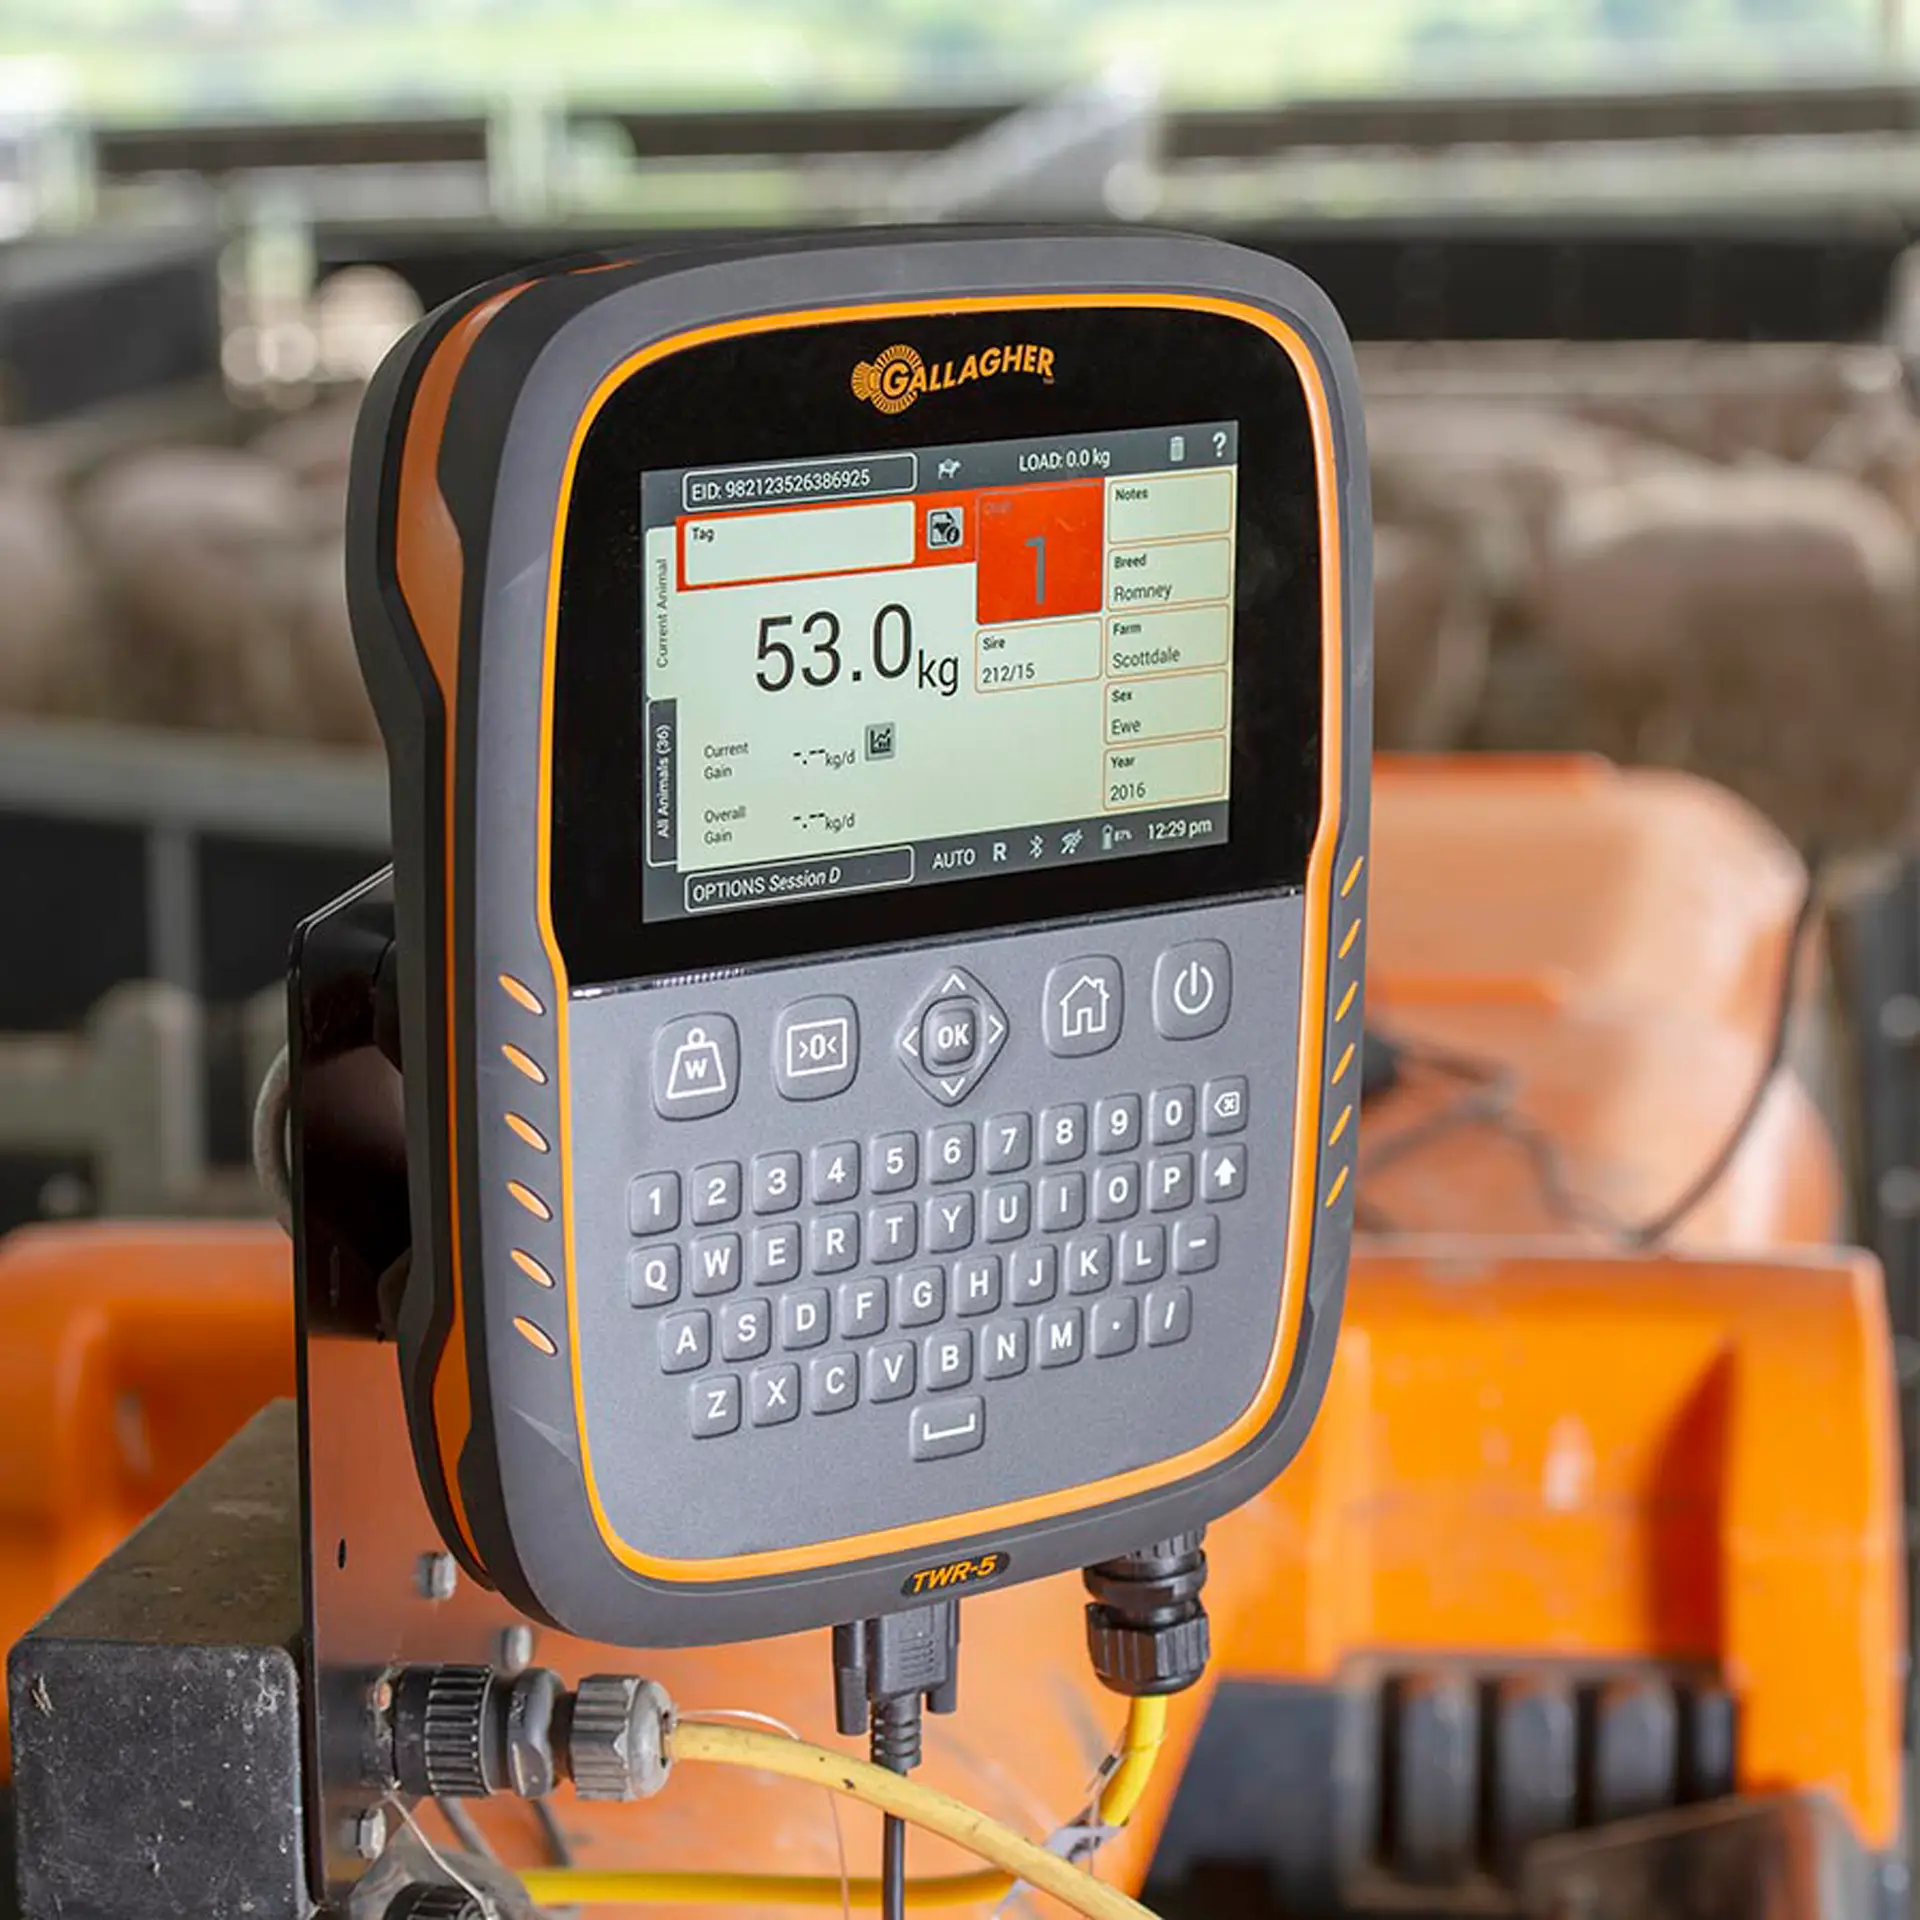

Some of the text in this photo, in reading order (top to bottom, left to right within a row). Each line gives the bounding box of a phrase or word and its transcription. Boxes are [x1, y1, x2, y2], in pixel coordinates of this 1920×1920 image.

[884, 344, 1055, 397] GALLAGHER
[1019, 447, 1110, 472] LOAD: 0.0 kg
[692, 468, 870, 502] EID: 982123526386925
[1115, 487, 1148, 502] Notes
[692, 527, 714, 543] Tag
[1025, 537, 1046, 605] 1
[1114, 553, 1146, 569] Breed
[1114, 581, 1172, 602] Romney
[656, 558, 668, 669] Current Animal
[1113, 622, 1142, 636] Farm
[983, 636, 1006, 651] Sire
[1112, 646, 1181, 670] Scottdale
[982, 663, 1036, 684] 212/15
[1112, 690, 1133, 703] Sex
[1112, 719, 1142, 735] Ewe
[703, 741, 750, 760] Current
[703, 764, 733, 781] Gain
[1111, 755, 1136, 770] Year
[656, 756, 669, 816] Animals
[1110, 782, 1146, 802] 2016
[703, 805, 746, 824] Overall
[656, 818, 669, 839] All
[703, 828, 733, 845] Gain
[1148, 819, 1213, 840] 12:29 pm
[932, 847, 976, 870] AUTO
[993, 842, 1006, 862] R
[693, 865, 841, 902] OPTIONS Session D
[937, 1023, 969, 1049] OK
[685, 1058, 708, 1080] W
[649, 1099, 1183, 1215] 1 2 3 4 5 6 7 8 9 0
[645, 1166, 1181, 1292] Q W E R T Y U I O P
[676, 1325, 697, 1354] A
[737, 1314, 756, 1342] S
[796, 1303, 816, 1331] D
[856, 1291, 873, 1320] F
[913, 1280, 932, 1308] G
[970, 1269, 988, 1298] H
[1028, 1259, 1042, 1287] J
[1080, 1248, 1099, 1277] K
[1136, 1239, 1152, 1266] L
[707, 1390, 727, 1419] Z
[767, 1377, 787, 1407] X
[826, 1366, 845, 1394] C
[883, 1354, 903, 1383] V
[941, 1344, 959, 1372] B
[997, 1332, 1016, 1361] N
[1051, 1321, 1072, 1350] M
[912, 1554, 998, 1594] TWR-5
